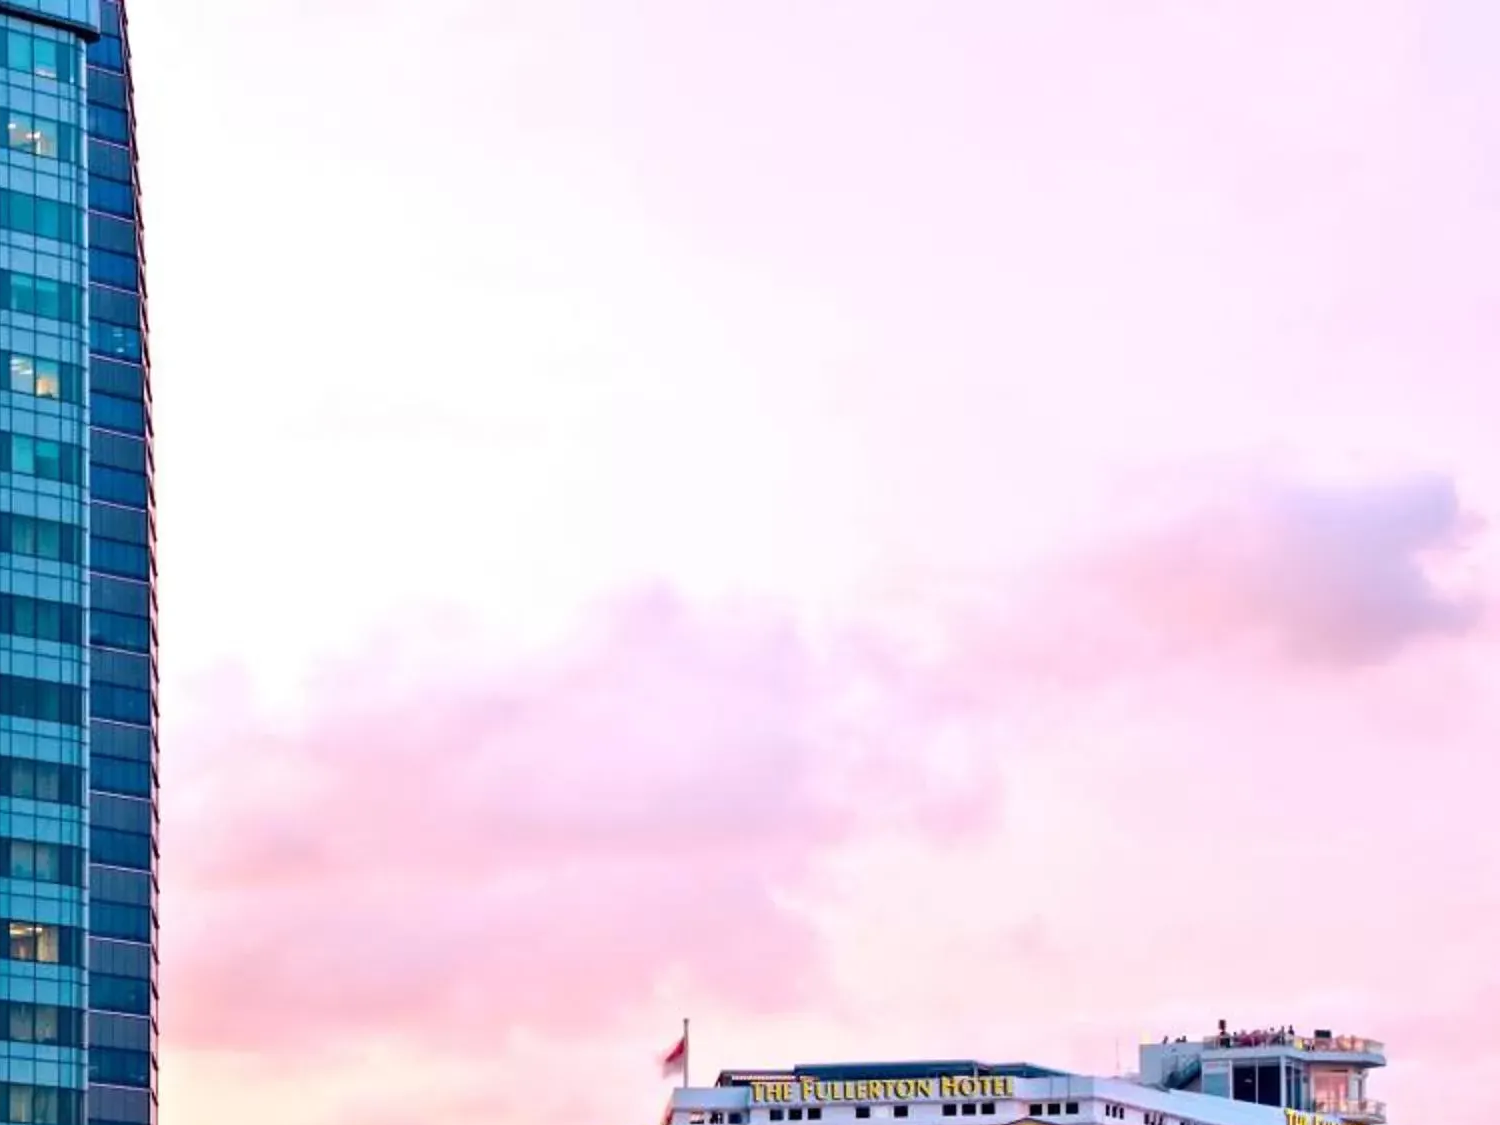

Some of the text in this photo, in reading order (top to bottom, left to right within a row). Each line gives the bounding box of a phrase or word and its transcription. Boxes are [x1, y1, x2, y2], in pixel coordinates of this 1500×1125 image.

[751, 1075, 1013, 1102] THE FULLERTON HOTEL
